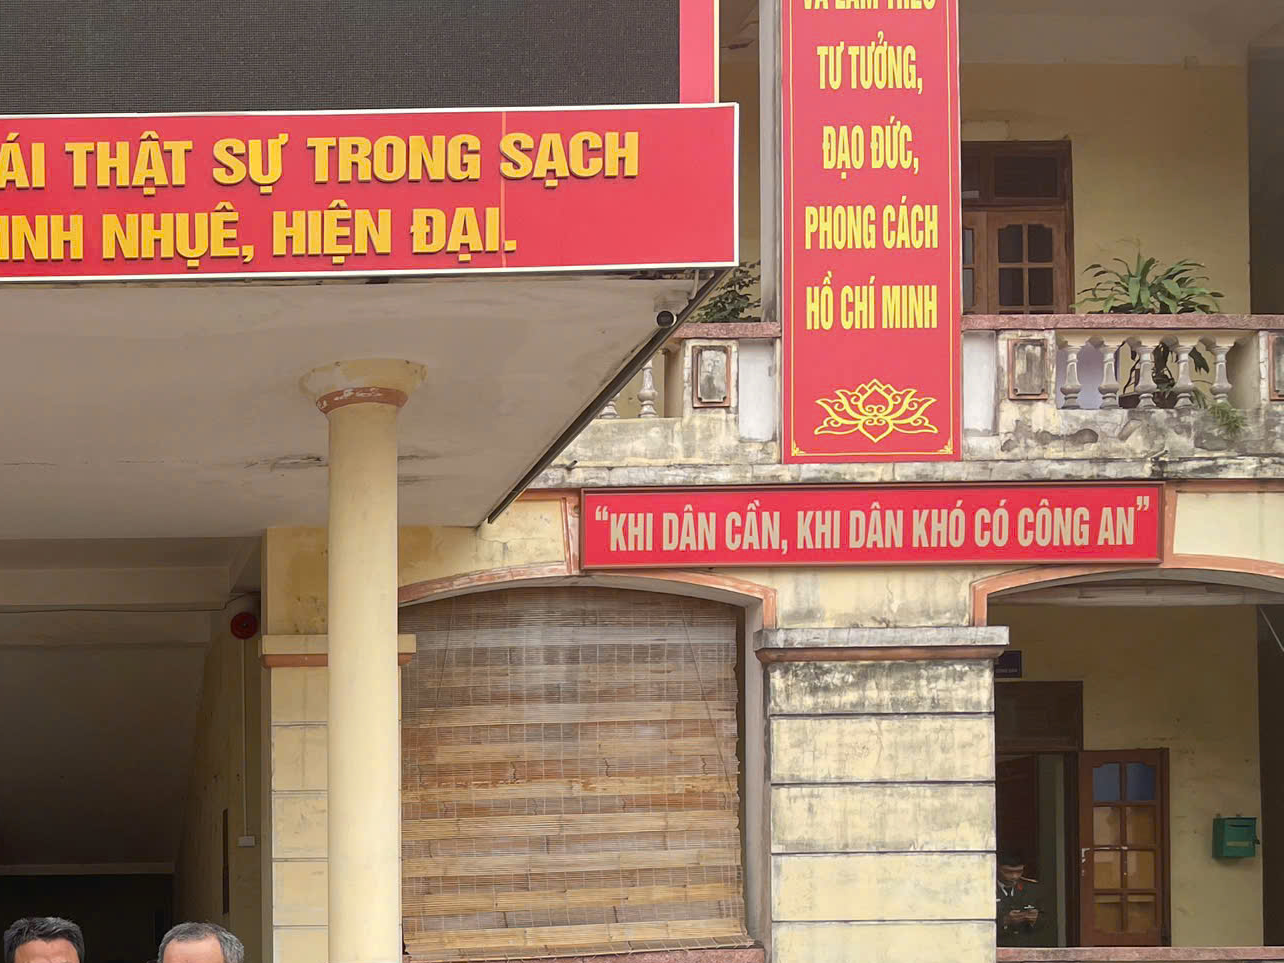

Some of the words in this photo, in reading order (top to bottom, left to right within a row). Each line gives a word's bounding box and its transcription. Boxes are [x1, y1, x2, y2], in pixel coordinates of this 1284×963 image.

[816, 41, 845, 89] TƯ
[848, 31, 923, 94] TƯỞNG,
[65, 130, 193, 195] THẬT
[212, 133, 289, 193] SỰ
[307, 134, 481, 182] TRONG
[499, 131, 639, 188] SẠCH
[822, 125, 865, 179] ĐẠO
[870, 116, 919, 174] ĐỨC,
[272, 200, 392, 264] HIỆN
[410, 207, 517, 262] ĐẠI.
[804, 205, 876, 249] PHONG
[882, 195, 939, 249] CÁCH
[805, 271, 834, 330] HỒ
[841, 276, 876, 330] CHÍ
[881, 285, 938, 329] MINH
[662, 503, 716, 551] DÂN
[725, 499, 788, 555] CẦN,
[796, 510, 841, 550] KHI
[849, 502, 904, 549] DÂN
[912, 499, 966, 548] KHÓ
[974, 499, 1009, 547] CÓ
[1017, 498, 1090, 547] CÔNG
